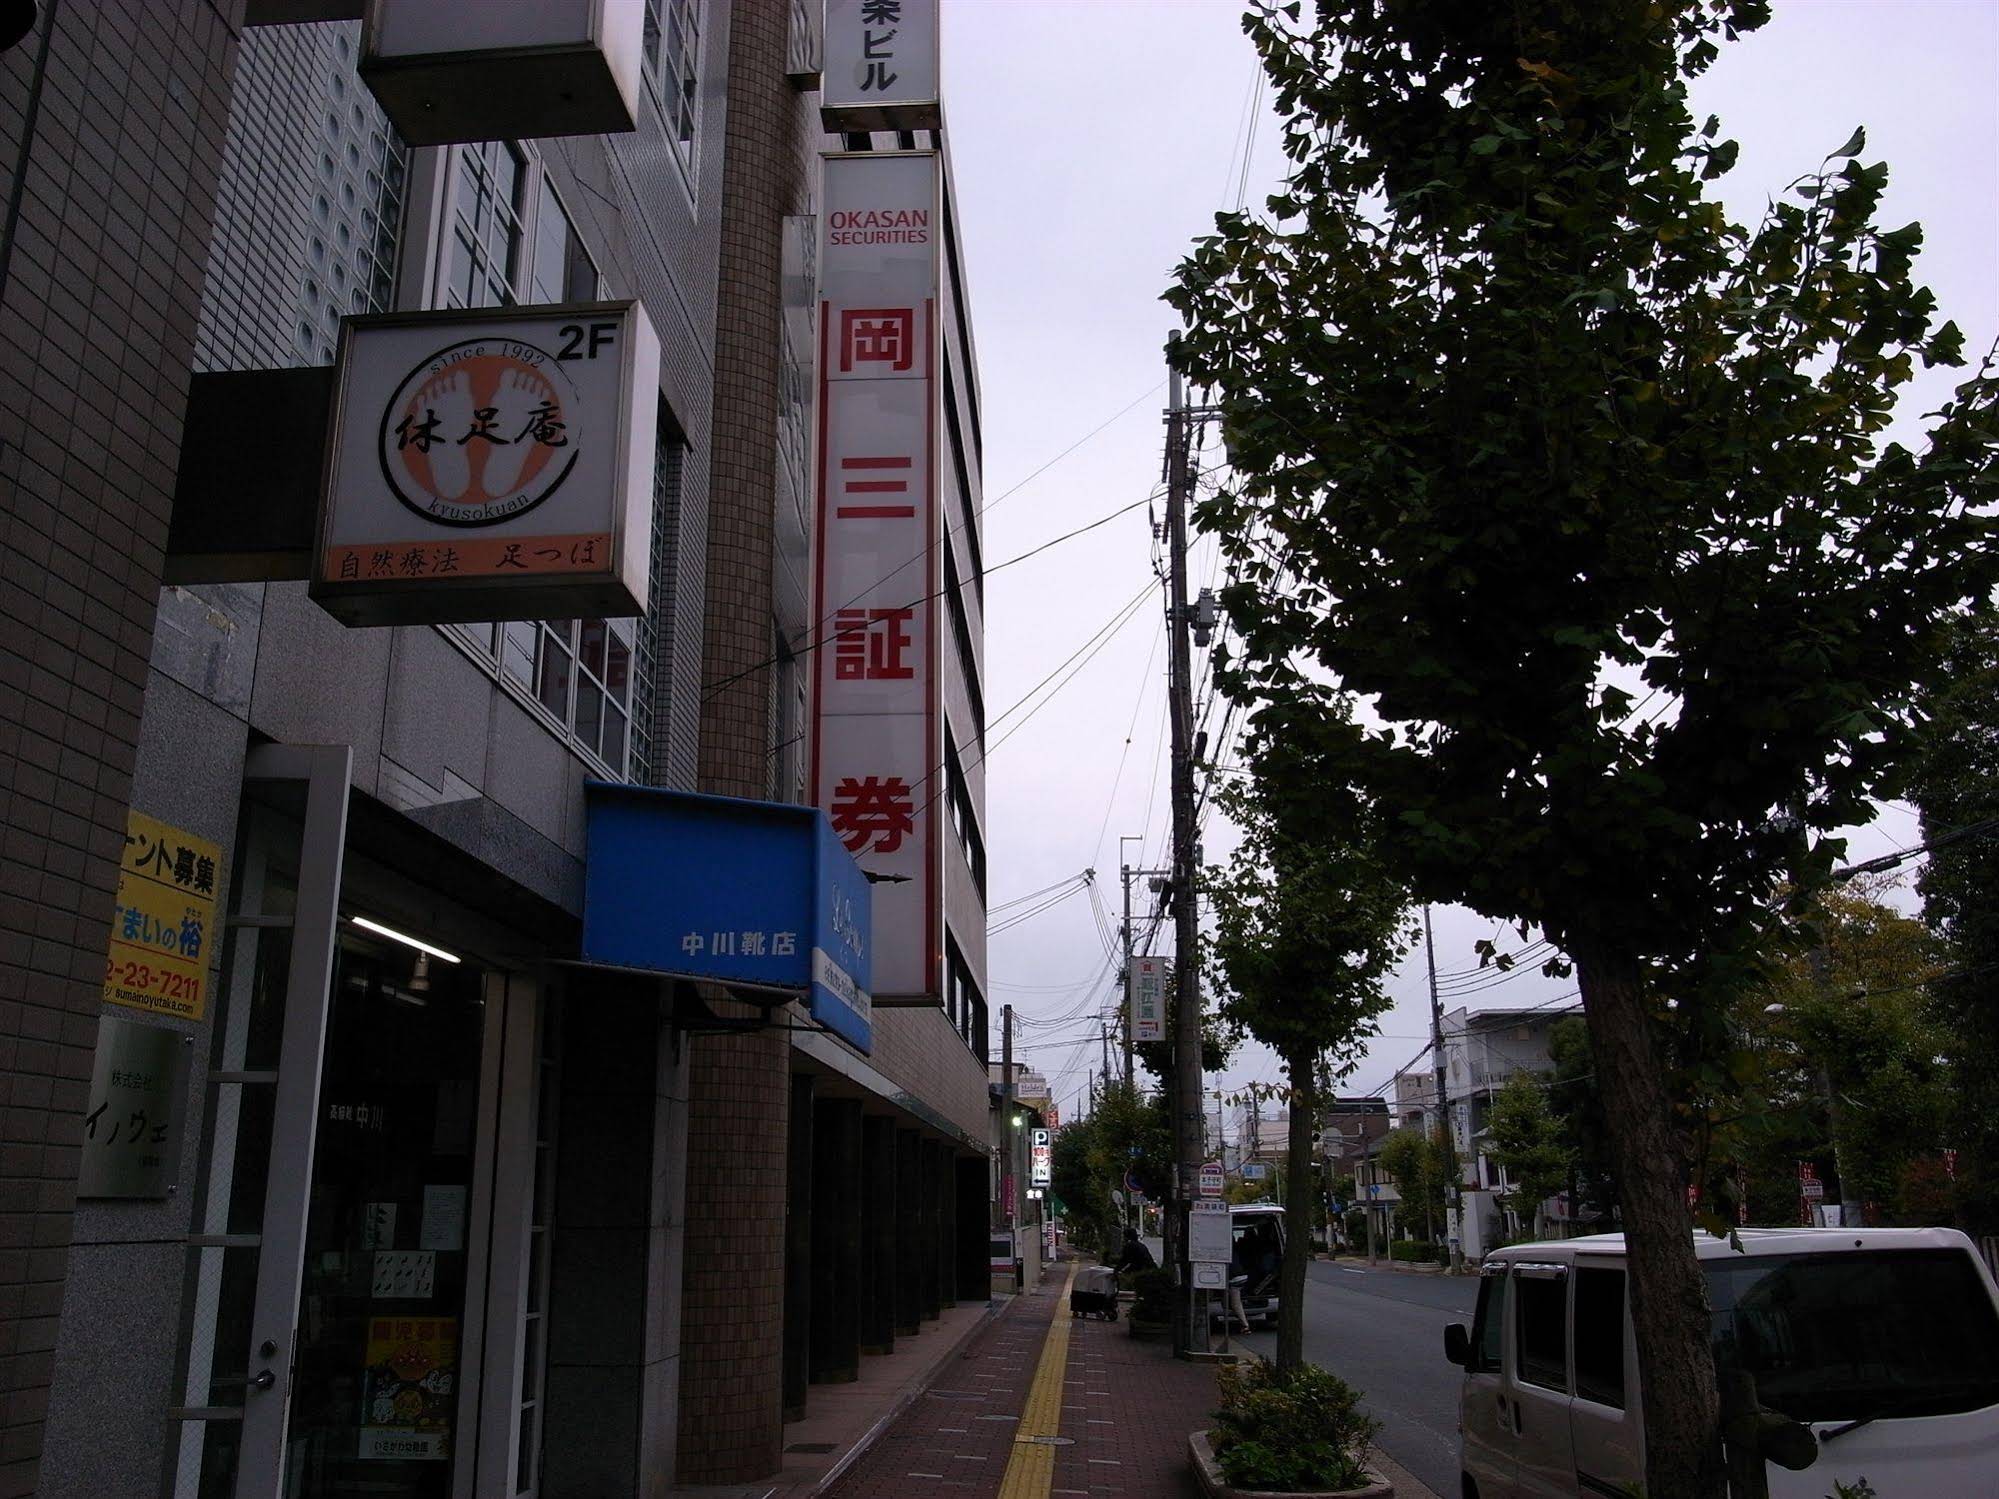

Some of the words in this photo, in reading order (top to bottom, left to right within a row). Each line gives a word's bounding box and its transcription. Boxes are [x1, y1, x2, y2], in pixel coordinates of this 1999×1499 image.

[830, 210, 928, 229] OKASAN
[830, 230, 928, 245] SECURITIES
[556, 323, 617, 361] 2F
[430, 344, 486, 375] since
[499, 343, 546, 368] 1992
[395, 401, 567, 453] 休足庵
[428, 494, 529, 520] kyusokuan
[340, 548, 460, 580] 自然療法
[495, 536, 603, 569] 足つぼ
[830, 308, 915, 853] 岡三証券
[114, 907, 204, 957] まいの裕
[680, 931, 797, 957] 中川靴店
[115, 989, 194, 1014] sumainoyutaka.com
[356, 1100, 384, 1130] 中川
[1035, 1131, 1048, 1145] P
